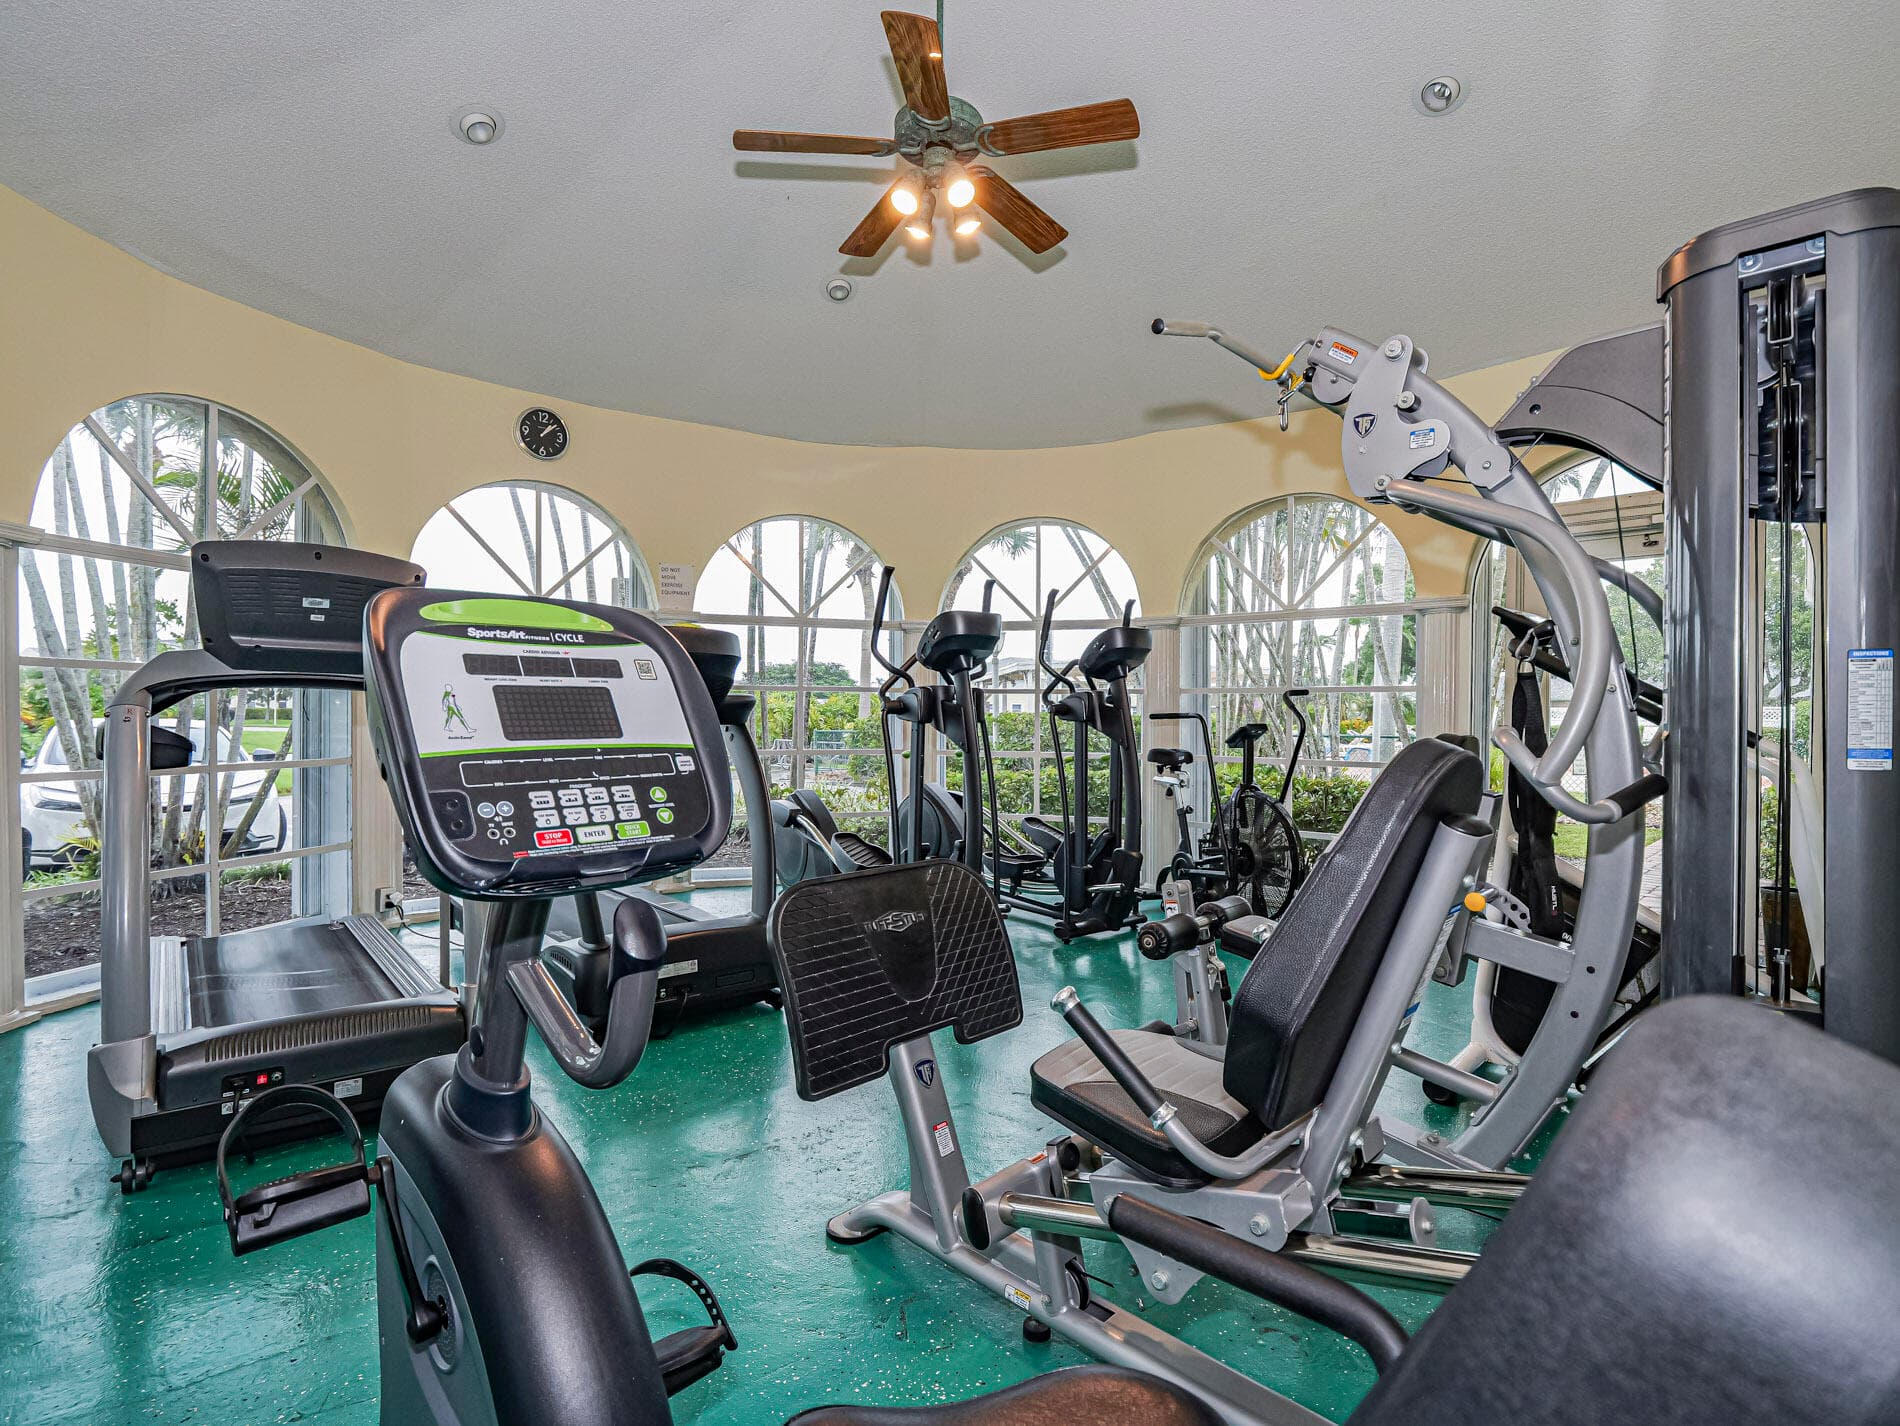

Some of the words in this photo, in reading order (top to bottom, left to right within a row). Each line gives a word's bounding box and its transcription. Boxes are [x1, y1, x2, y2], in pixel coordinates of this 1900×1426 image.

[538, 411, 549, 424] 12
[521, 425, 530, 436] 9
[556, 432, 563, 443] 3
[539, 446, 547, 456] 6
[467, 627, 526, 639] SportsArt
[555, 632, 585, 643] CYCLE
[543, 832, 563, 840] STOP
[583, 829, 606, 838] ENTER
